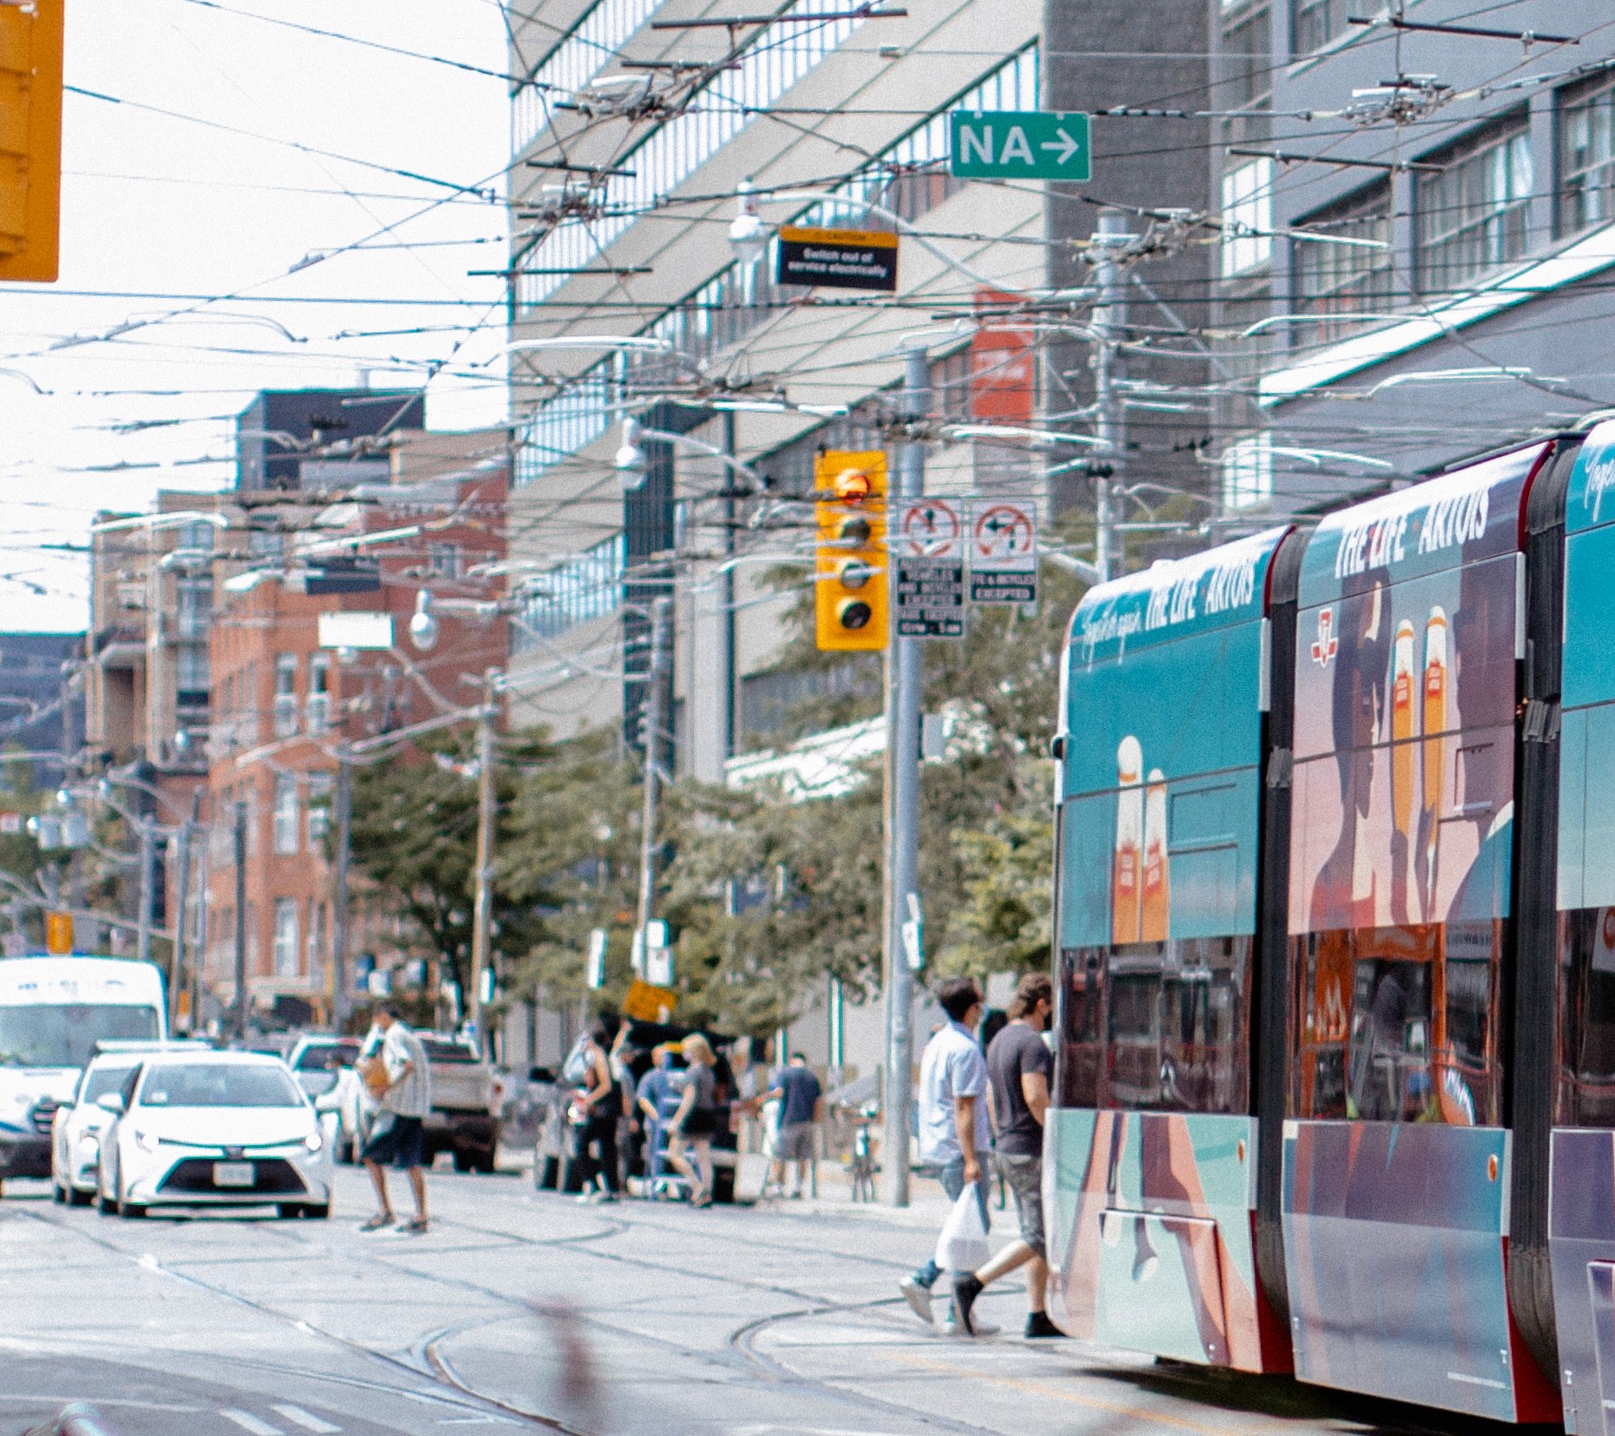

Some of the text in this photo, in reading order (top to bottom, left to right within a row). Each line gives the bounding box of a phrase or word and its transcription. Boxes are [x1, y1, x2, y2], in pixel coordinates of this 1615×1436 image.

[959, 124, 1036, 166] NA
[1335, 489, 1489, 579] THE LIFE ARTOIS
